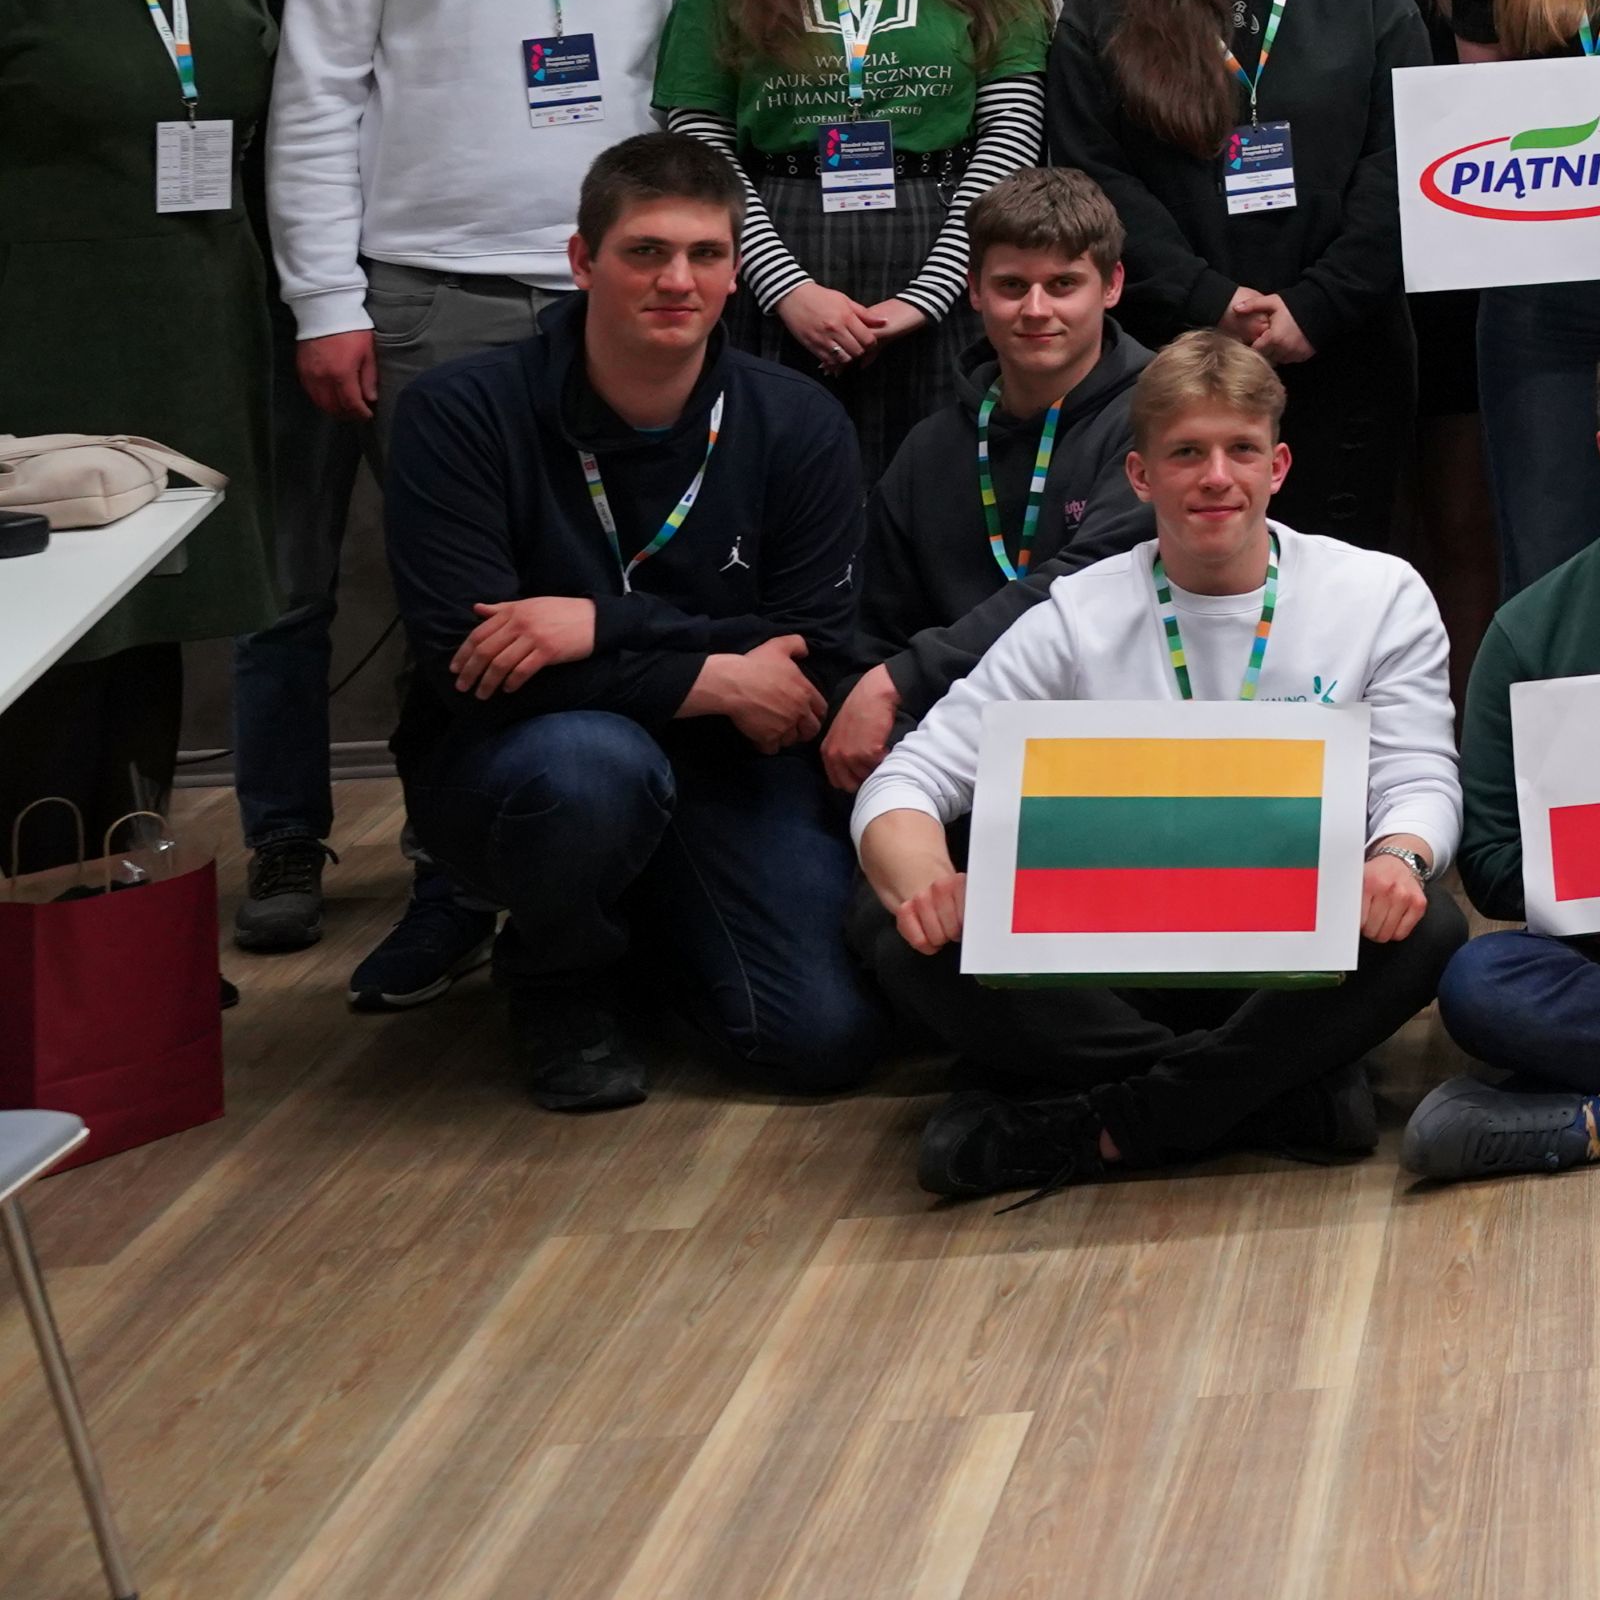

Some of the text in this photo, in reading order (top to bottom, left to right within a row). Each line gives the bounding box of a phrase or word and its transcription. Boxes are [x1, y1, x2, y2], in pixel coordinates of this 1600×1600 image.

[814, 51, 900, 69] WYZIAŁ
[762, 65, 952, 92] NAUK SPOECZNYCH
[768, 84, 953, 107] HUMANIYCZNYCH
